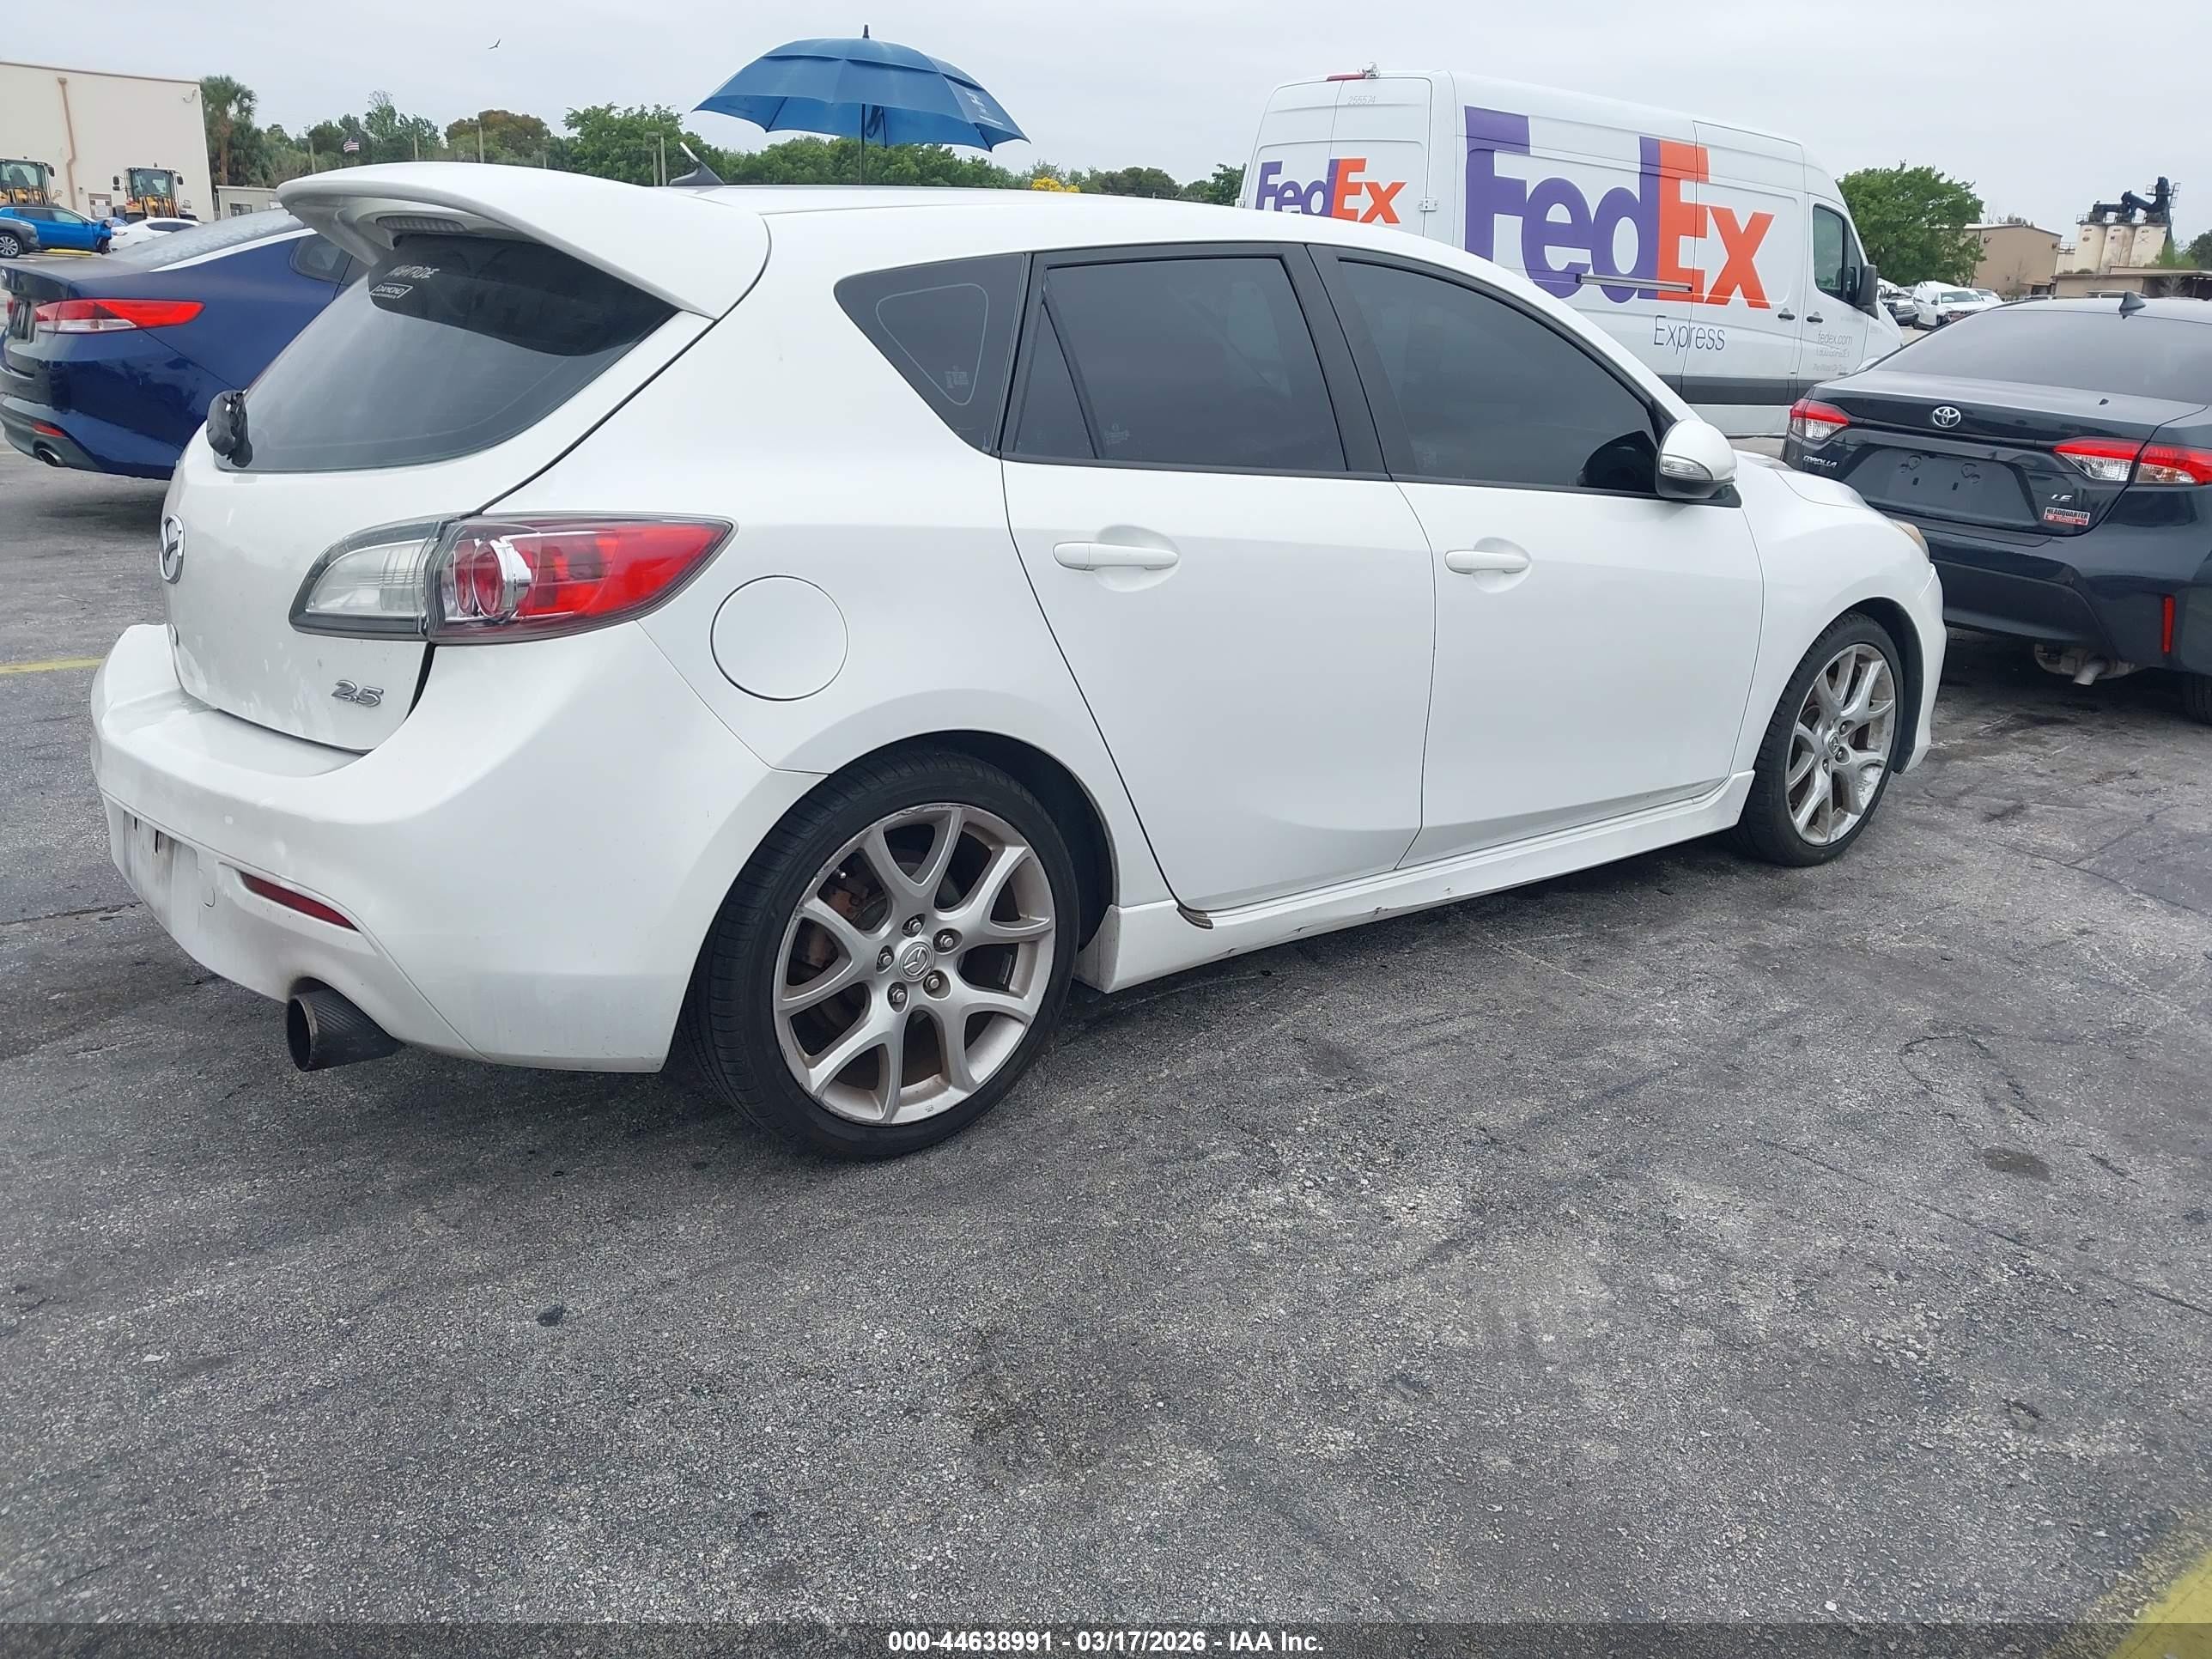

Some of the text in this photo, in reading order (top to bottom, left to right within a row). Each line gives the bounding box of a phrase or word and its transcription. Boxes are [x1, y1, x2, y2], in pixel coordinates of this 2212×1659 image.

[1255, 158, 1407, 223] FedEx
[1464, 106, 1775, 309] FedEx
[1654, 315, 1726, 355] Express
[1818, 331, 1853, 345] fedex.com
[2051, 494, 2073, 502] LE
[2046, 508, 2089, 520] HEADQUARTER
